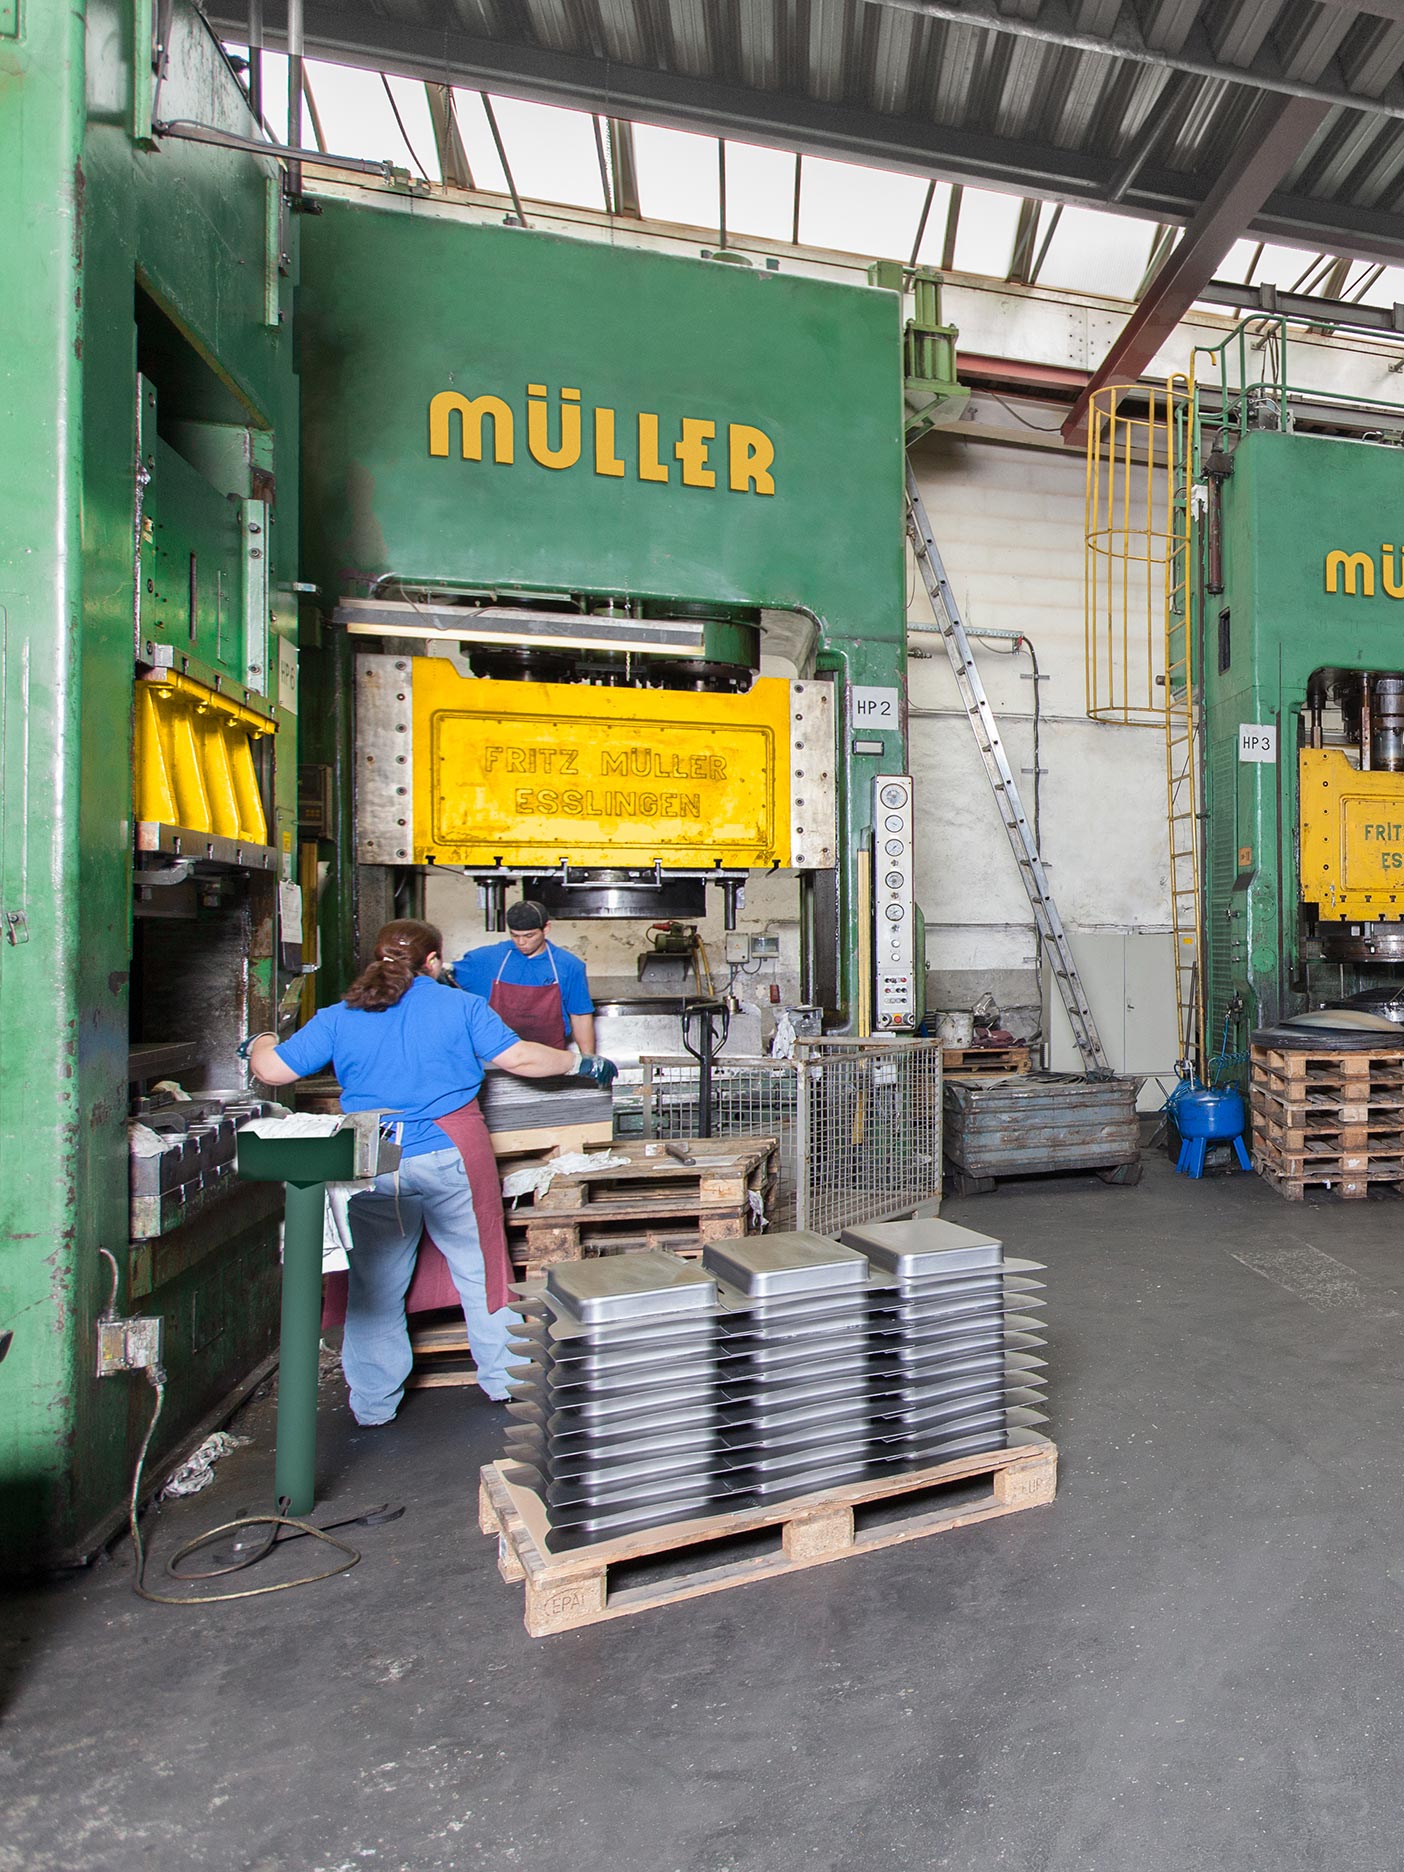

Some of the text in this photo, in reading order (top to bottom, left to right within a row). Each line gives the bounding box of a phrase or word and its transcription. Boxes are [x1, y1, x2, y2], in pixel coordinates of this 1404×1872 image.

[429, 382, 775, 496] MÜLLER
[484, 746, 728, 781] FRITZ MÜLLER
[515, 788, 700, 818] ESSLINGEN
